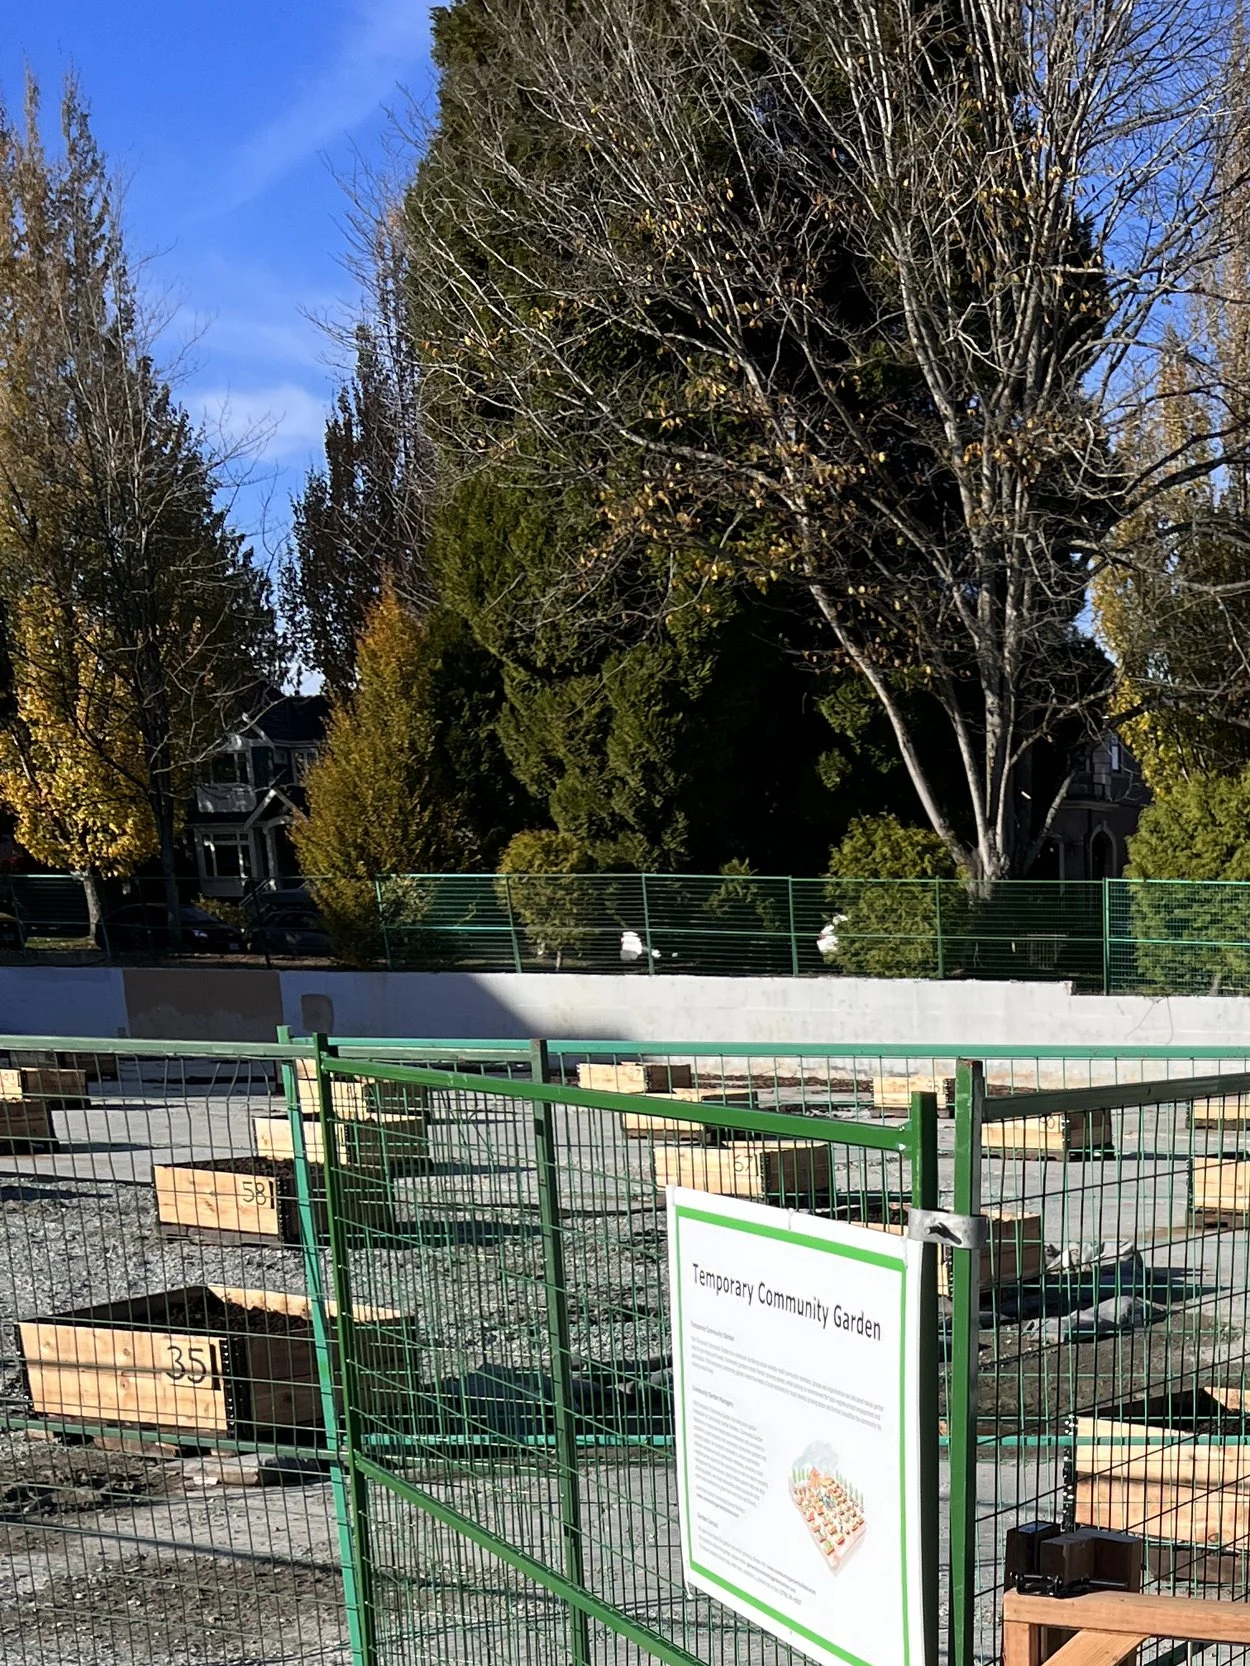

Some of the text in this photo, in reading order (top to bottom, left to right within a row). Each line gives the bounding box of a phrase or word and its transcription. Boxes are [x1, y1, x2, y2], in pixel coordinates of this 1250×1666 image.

[734, 1154, 754, 1172] 67
[242, 1181, 267, 1205] 58
[692, 1262, 882, 1342] Temporary Community Garden
[166, 1345, 207, 1384] 35
